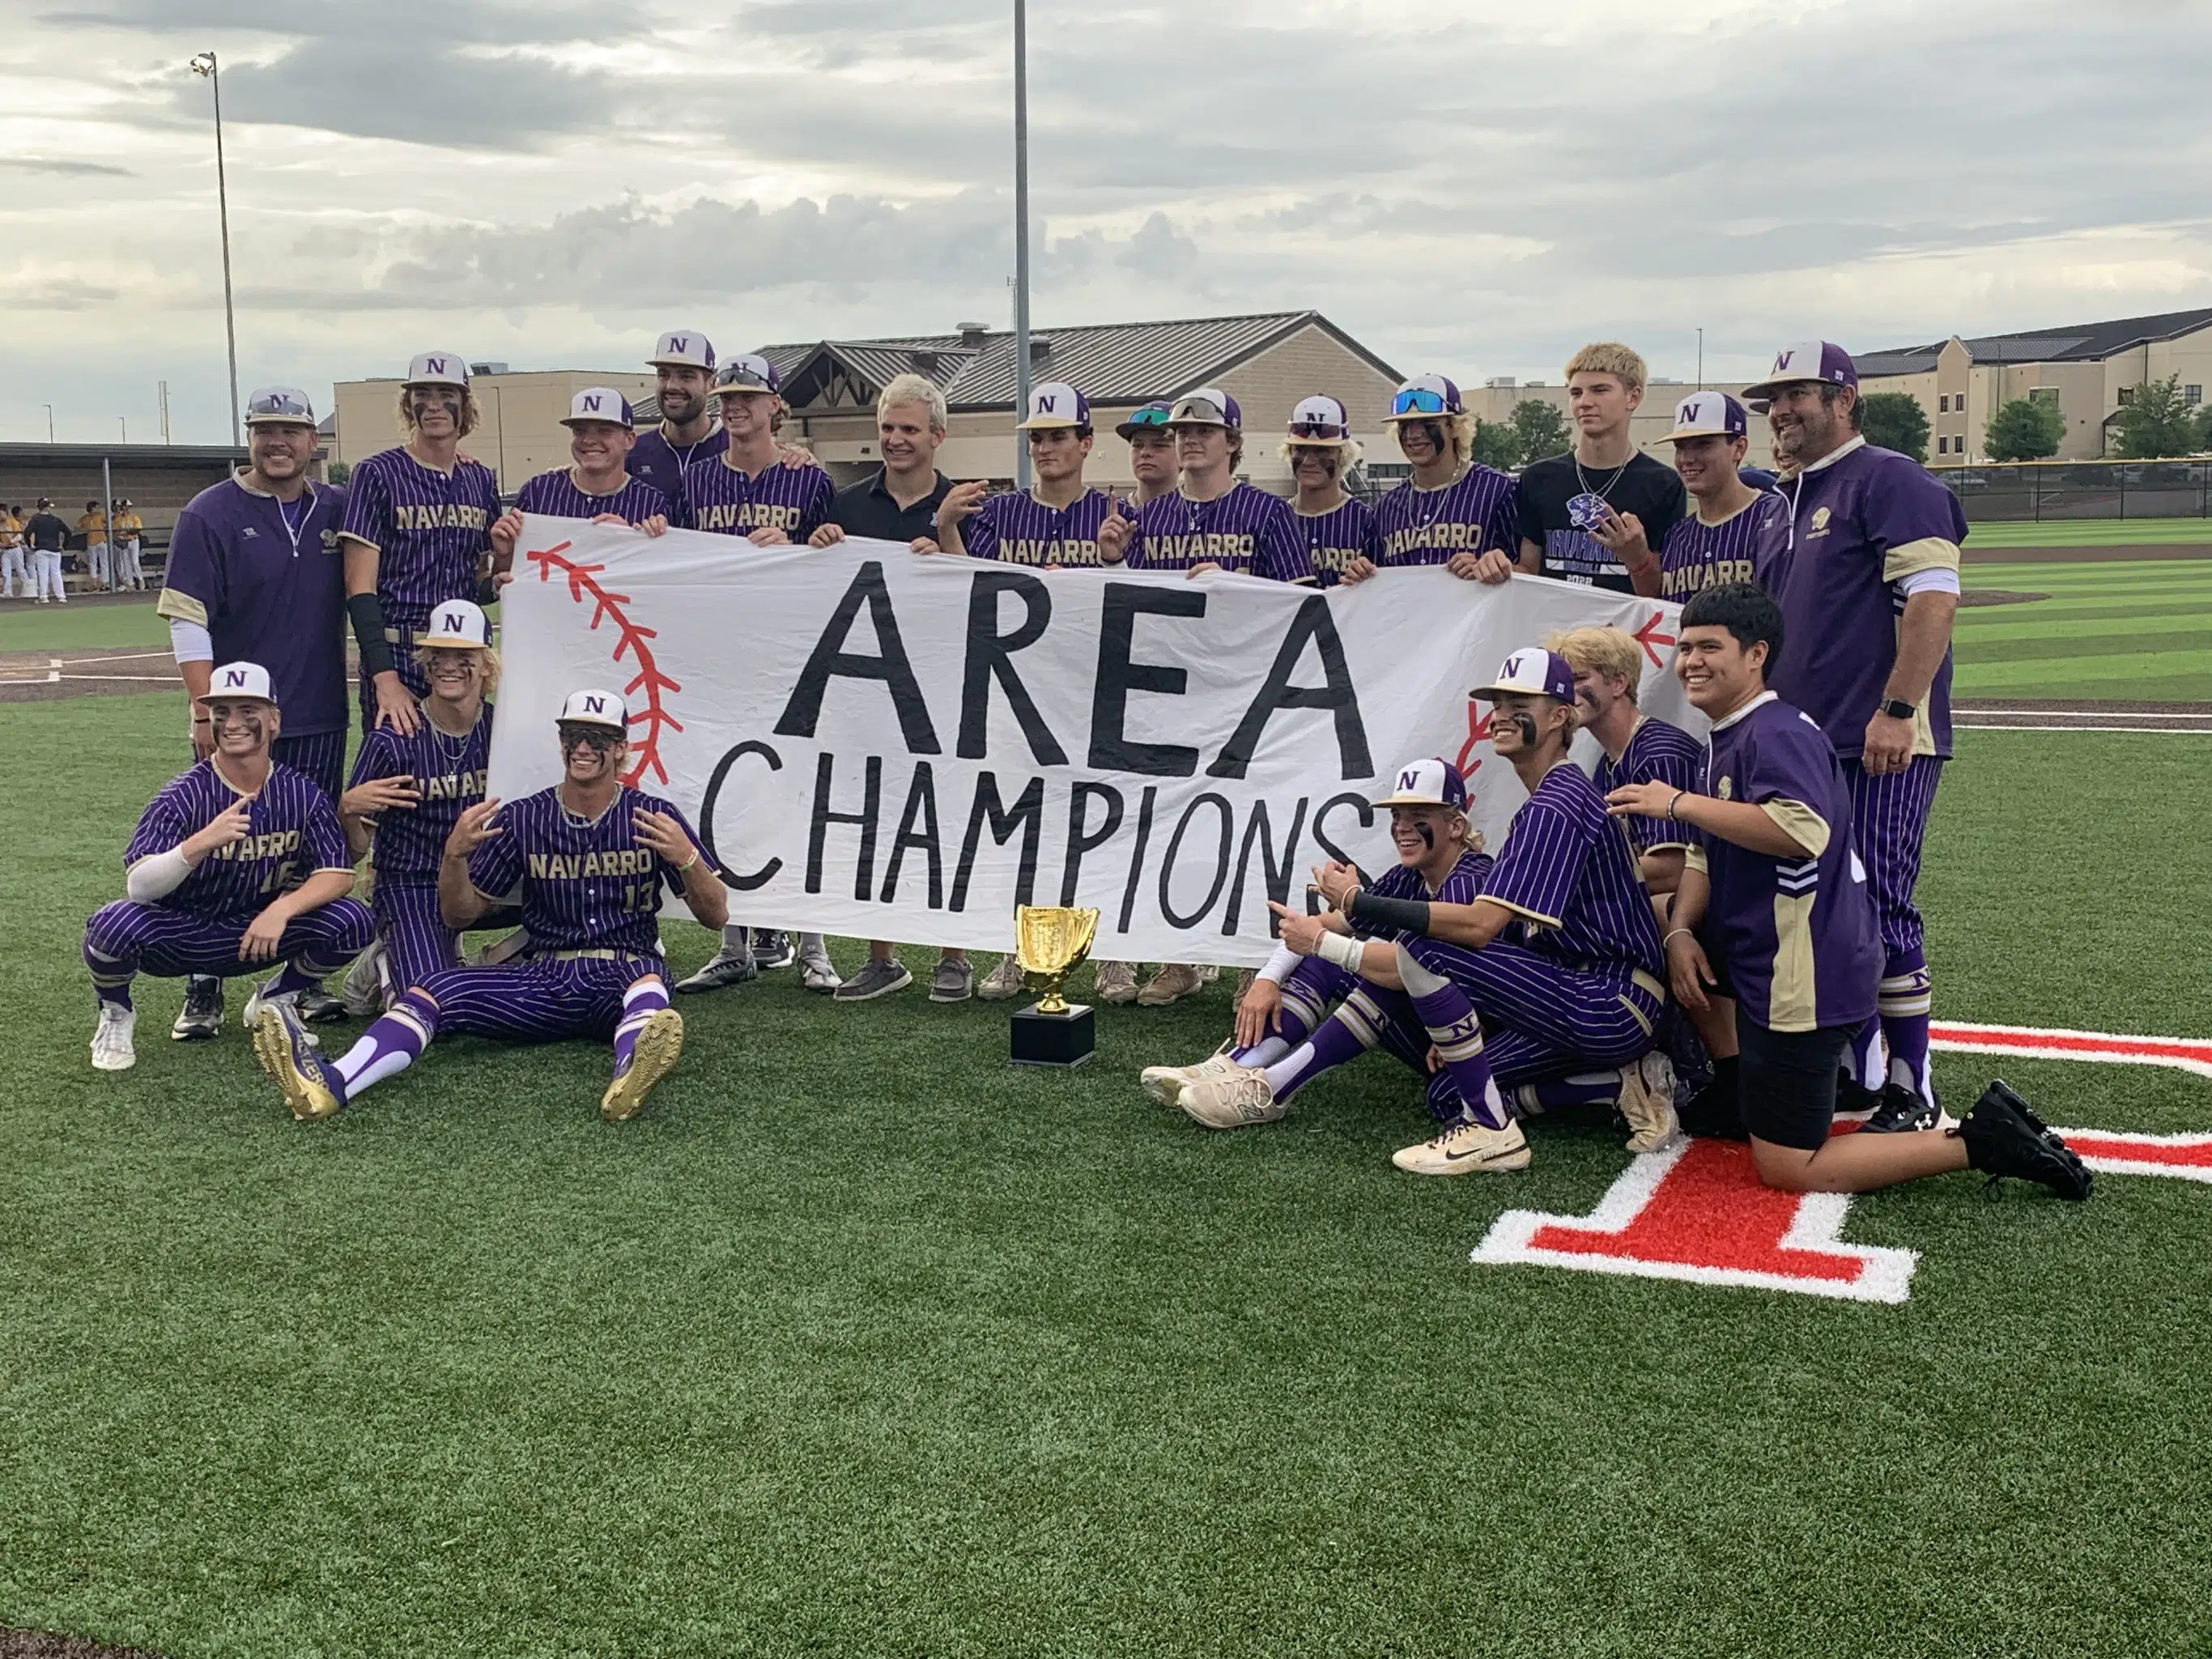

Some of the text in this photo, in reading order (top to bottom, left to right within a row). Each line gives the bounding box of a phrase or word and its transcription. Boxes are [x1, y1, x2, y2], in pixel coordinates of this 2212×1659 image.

[668, 337, 688, 353] N
[426, 359, 447, 374] N
[1771, 351, 1795, 376] N
[582, 395, 603, 411] N
[1037, 395, 1057, 414] N
[1678, 403, 1700, 424] N
[697, 503, 801, 530] NAVARRO
[998, 538, 1102, 565] NAVARR
[1144, 534, 1254, 561] NAVARRO
[1383, 523, 1482, 559] NAVARRO
[1661, 559, 1753, 597] NAVARR
[442, 614, 466, 632] N
[224, 670, 248, 687] N
[773, 560, 1375, 781] AREA
[1499, 657, 1525, 679] N
[583, 696, 606, 713] N
[1397, 771, 1420, 790] N
[699, 740, 1376, 938] CHAMPIONS
[529, 849, 653, 879] NAVARRO
[1448, 1014, 1475, 1040] N
